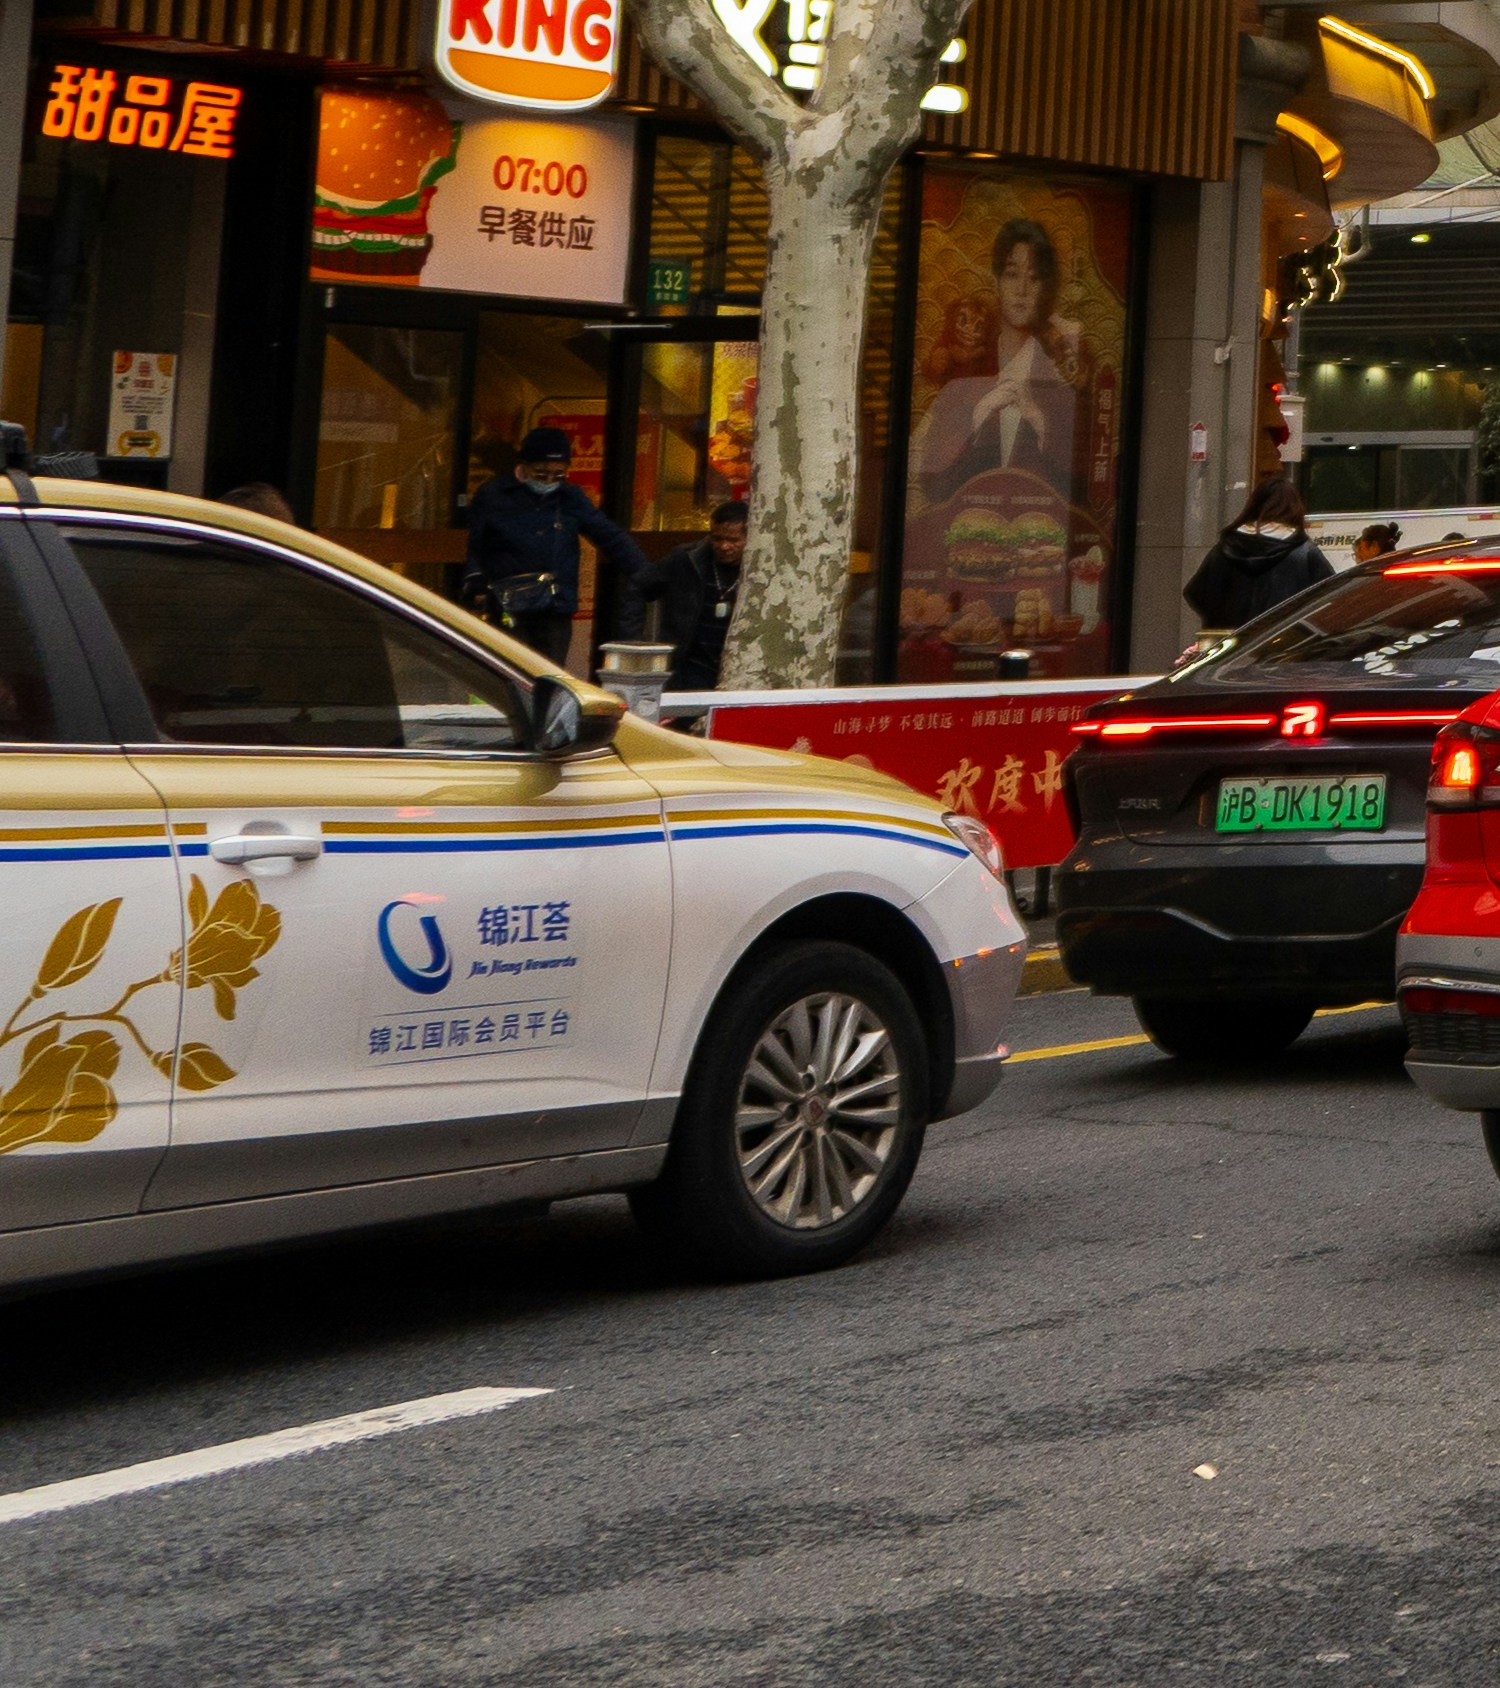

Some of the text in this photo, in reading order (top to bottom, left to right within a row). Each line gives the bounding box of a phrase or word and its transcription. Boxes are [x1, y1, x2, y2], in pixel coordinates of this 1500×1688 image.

[42, 64, 242, 159] 甜品屋
[493, 155, 588, 199] 07:00
[477, 205, 597, 252] 早餐供应
[653, 269, 684, 291] 132
[833, 714, 890, 736] 山海寻梦
[1220, 782, 1380, 824] 沪B·DK1918
[477, 900, 571, 947] 锦江荟
[487, 959, 523, 978] Jiang
[523, 955, 579, 972] Rewards
[366, 1008, 570, 1055] 锦江国际会员平台
